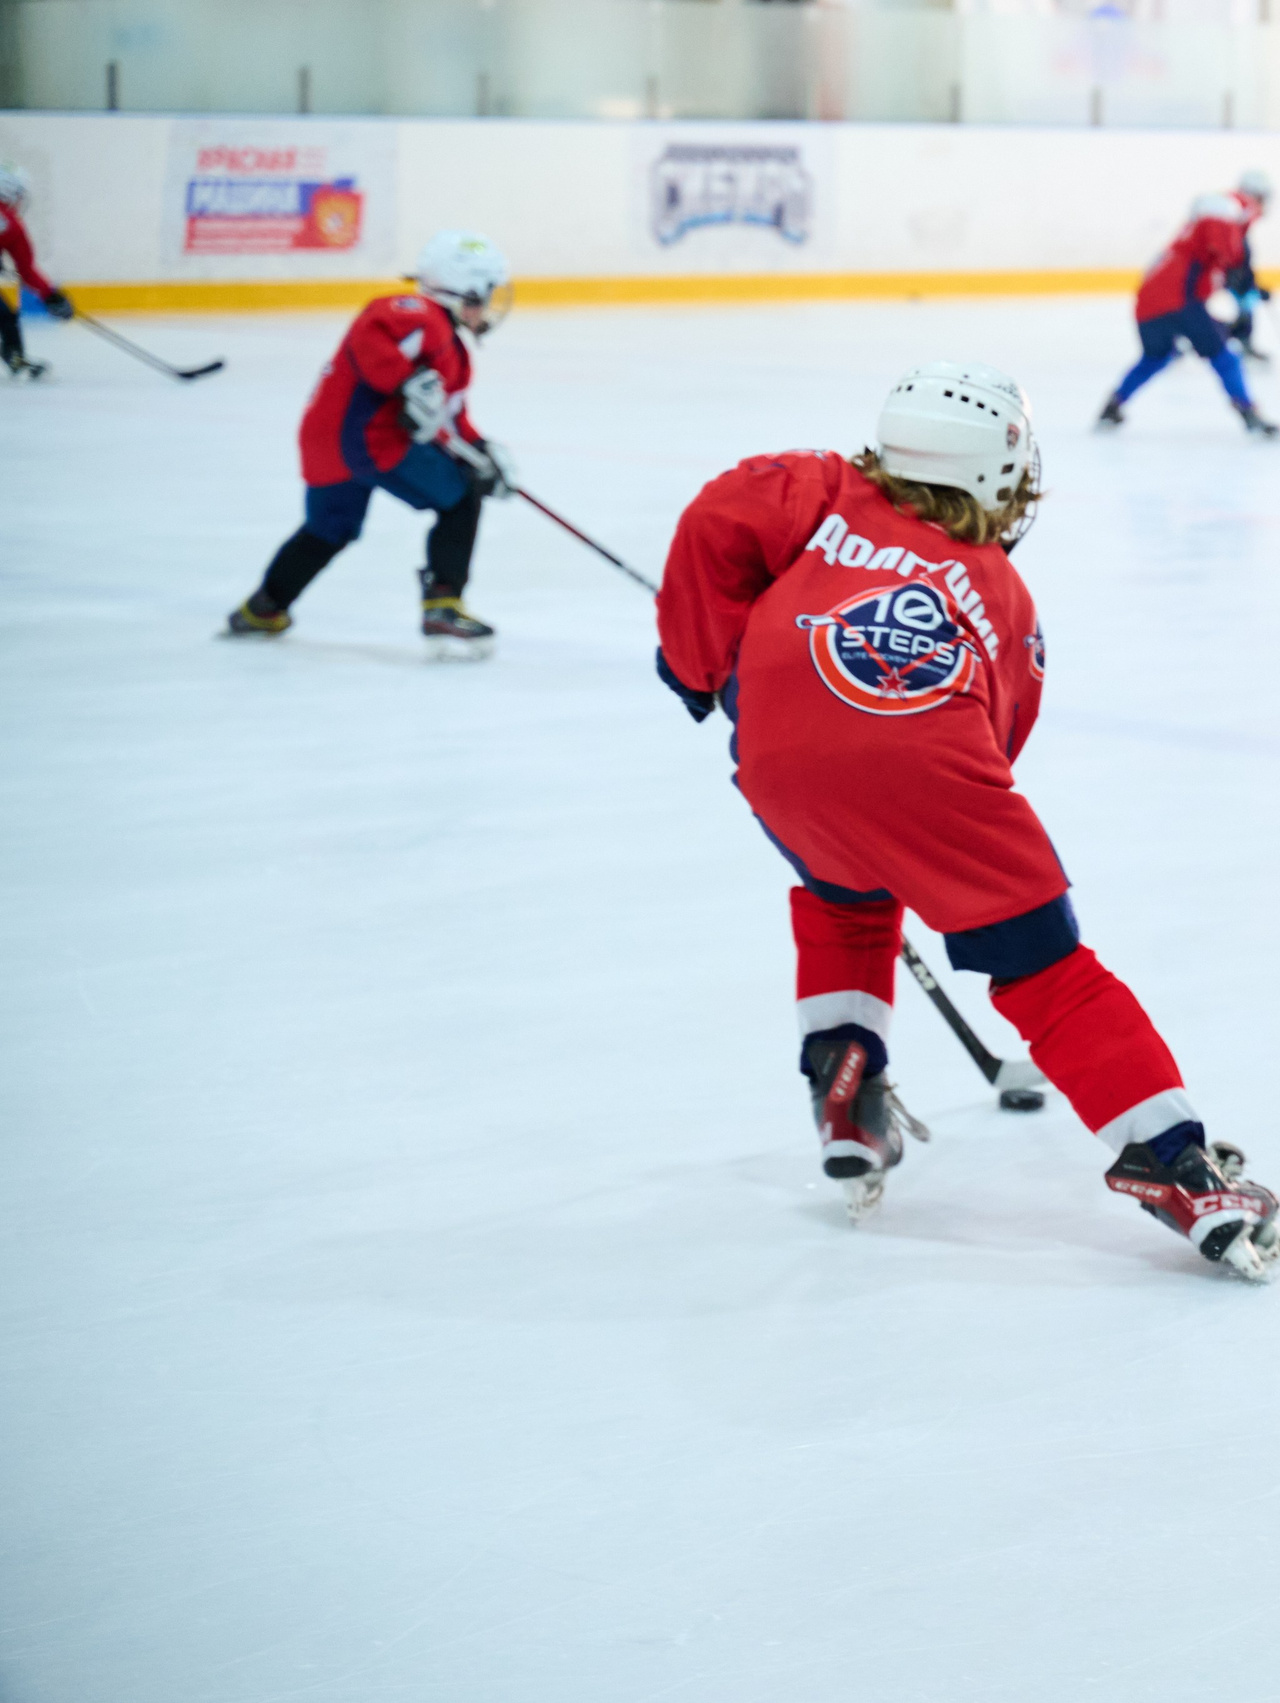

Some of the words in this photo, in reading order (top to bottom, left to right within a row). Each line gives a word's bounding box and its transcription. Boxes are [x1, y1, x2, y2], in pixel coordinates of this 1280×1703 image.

[873, 589, 944, 631] 10
[840, 625, 956, 666] STEPS
[1115, 1181, 1162, 1198] CCM
[1193, 1193, 1262, 1217] CCM
